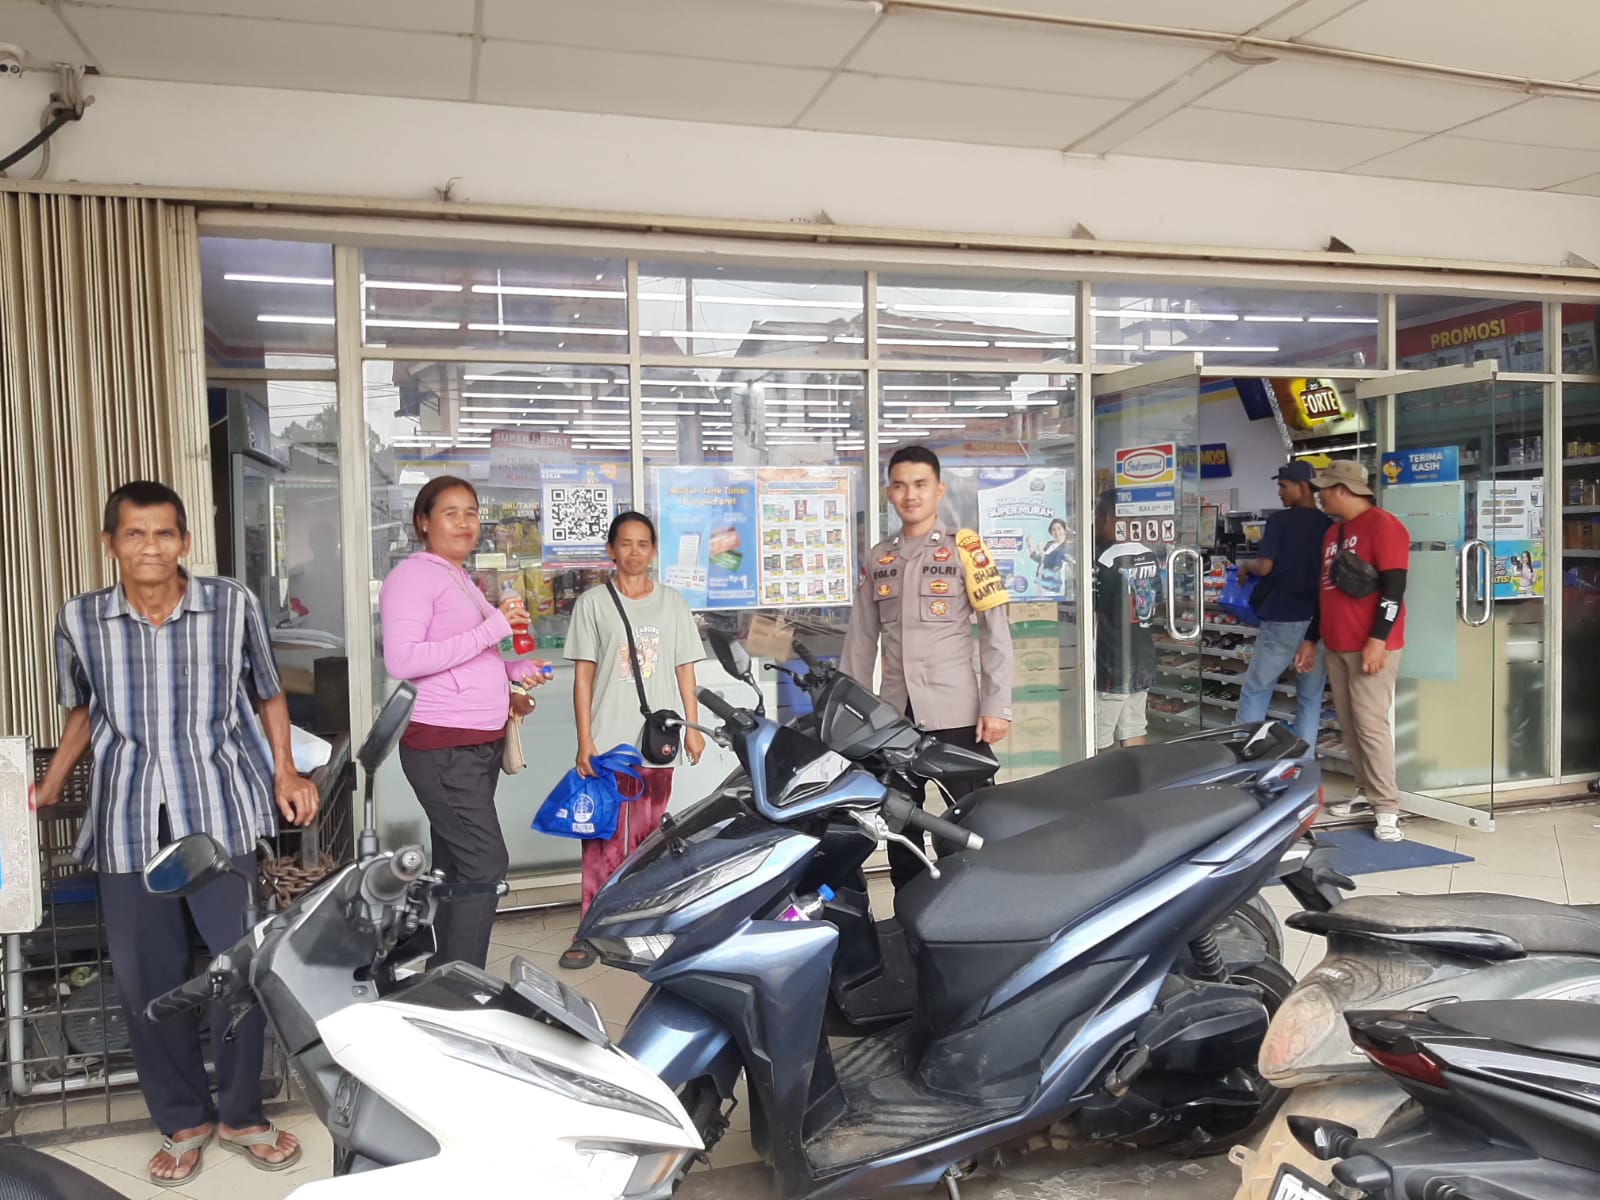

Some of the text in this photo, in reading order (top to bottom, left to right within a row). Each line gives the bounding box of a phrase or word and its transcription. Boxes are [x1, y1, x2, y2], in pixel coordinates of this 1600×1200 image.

[1430, 318, 1507, 350] PROMOSI
[1301, 390, 1339, 415] FORTE
[1408, 452, 1443, 463] TERIMA
[1411, 462, 1440, 473] KASIH
[987, 505, 1055, 518] SUPER MURAH
[922, 565, 957, 576] POLRI
